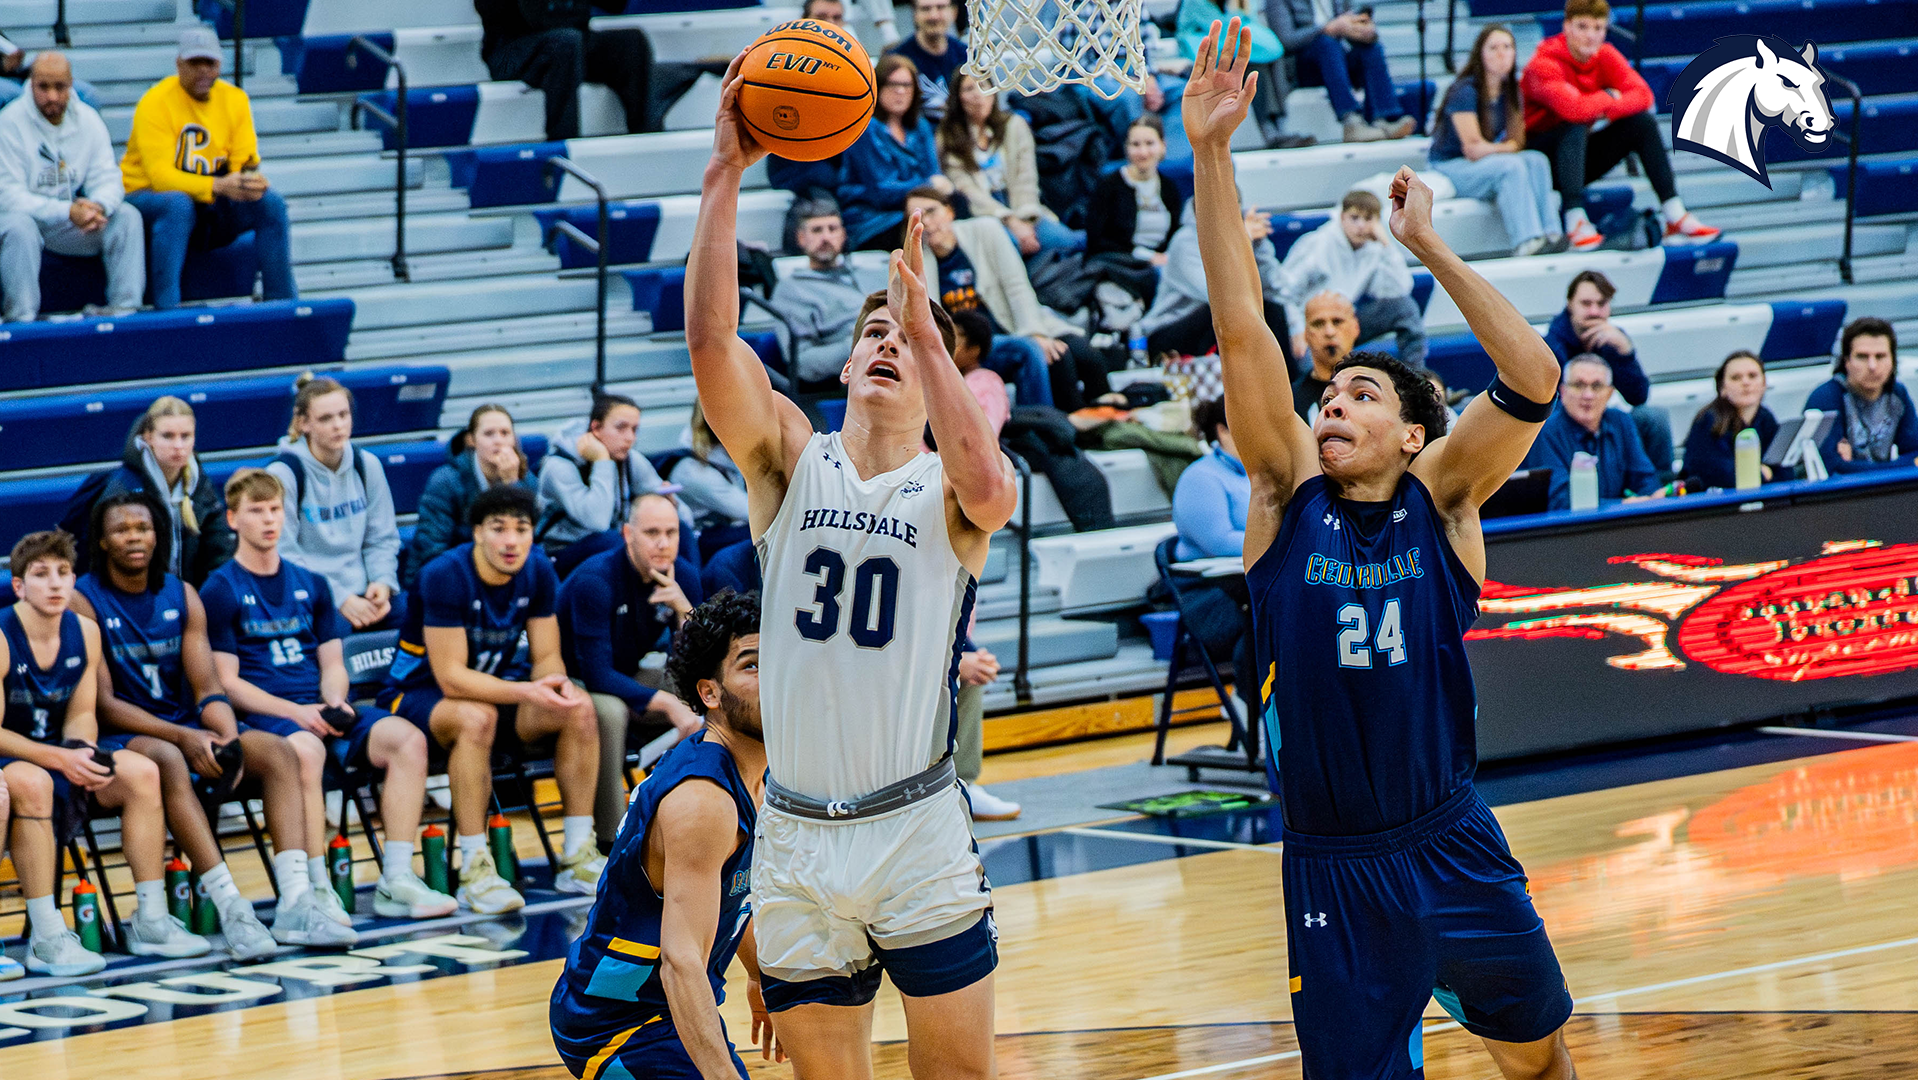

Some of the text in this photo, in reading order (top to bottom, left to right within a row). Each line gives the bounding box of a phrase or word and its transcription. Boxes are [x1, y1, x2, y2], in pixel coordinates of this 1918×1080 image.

[766, 53, 841, 75] EVO NXT
[1305, 547, 1425, 589] CEDRVILLE
[793, 544, 901, 651] 30
[269, 637, 304, 666] 12
[1337, 598, 1408, 669] 24
